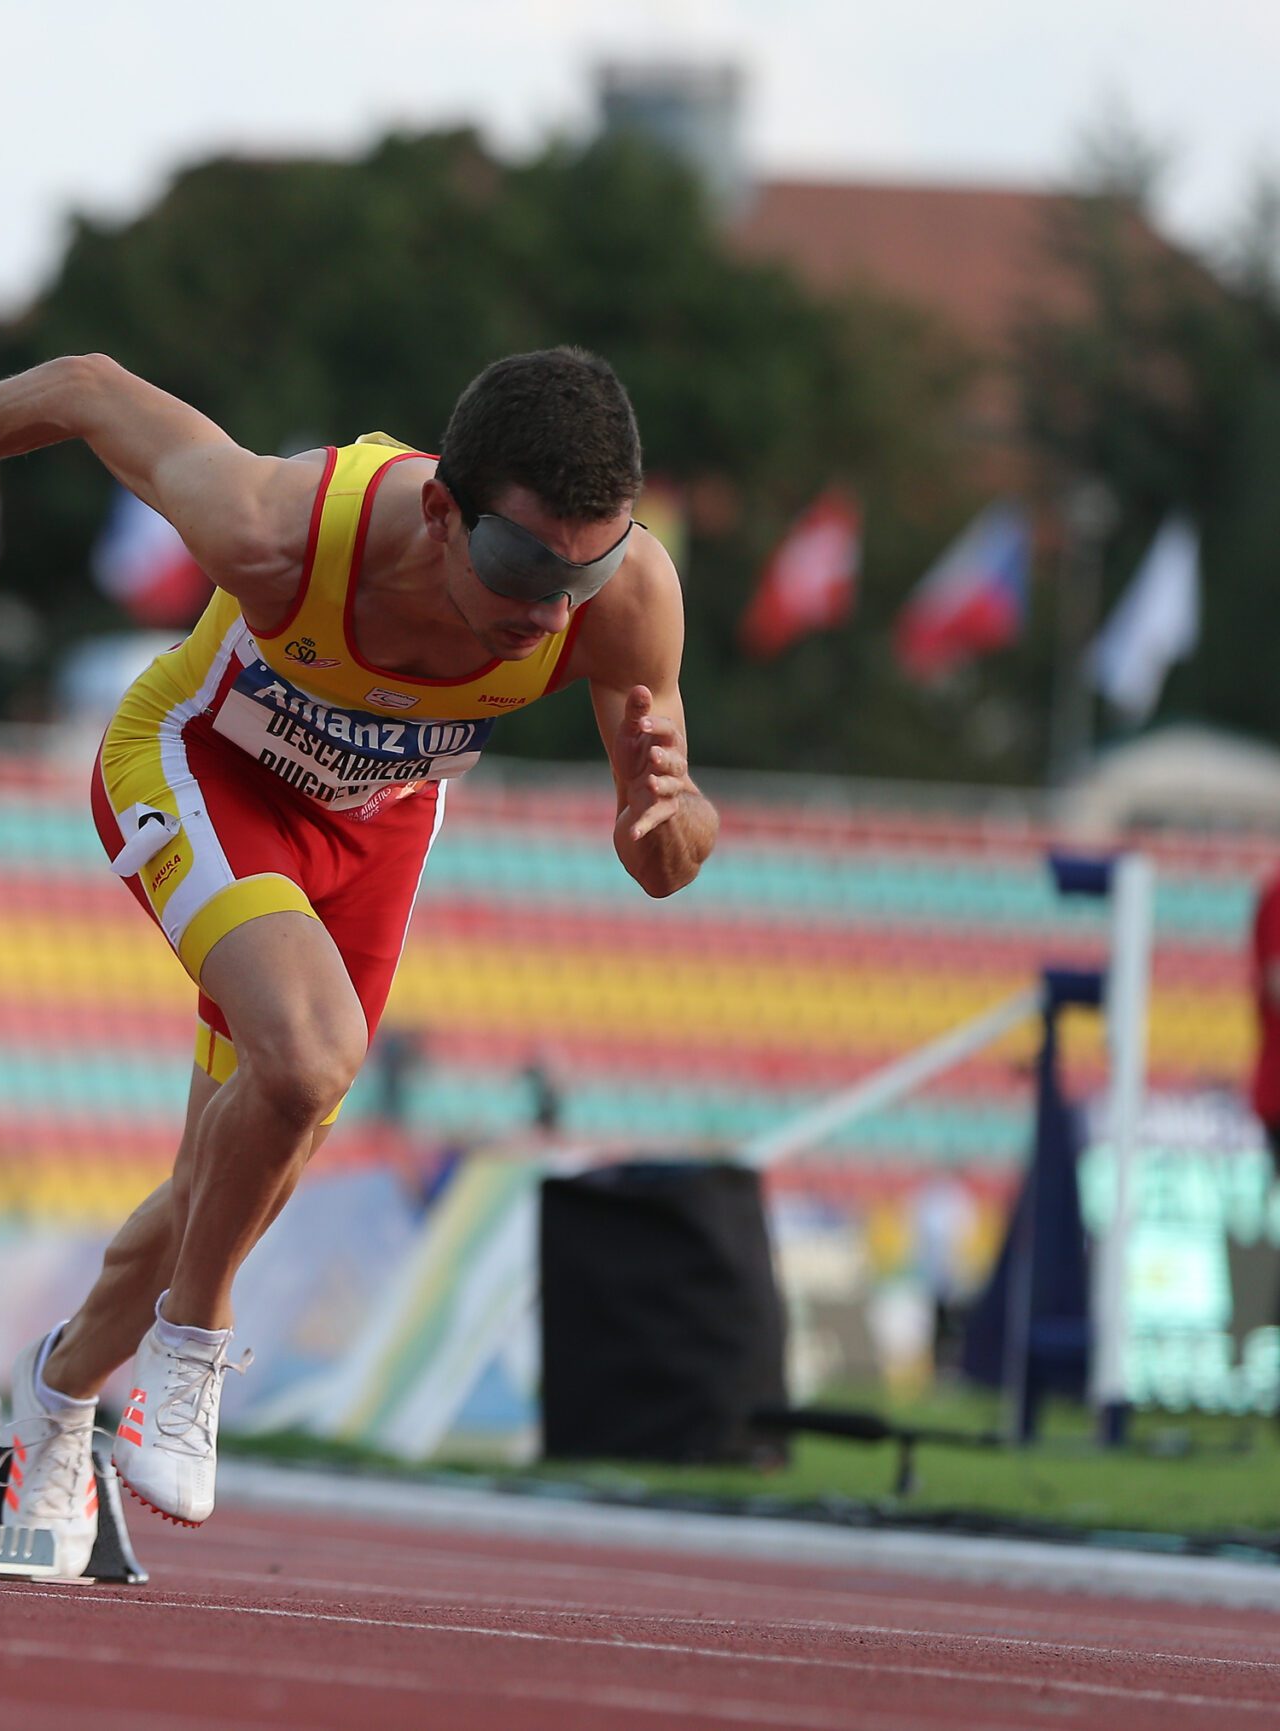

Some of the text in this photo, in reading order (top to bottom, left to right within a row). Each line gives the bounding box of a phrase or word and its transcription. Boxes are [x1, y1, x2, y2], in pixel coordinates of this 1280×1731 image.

[284, 641, 317, 665] CSD
[253, 679, 406, 755] Allianz
[478, 694, 527, 704] AMURA
[265, 710, 434, 782] DESCARREGA
[152, 854, 181, 893] AMURA
